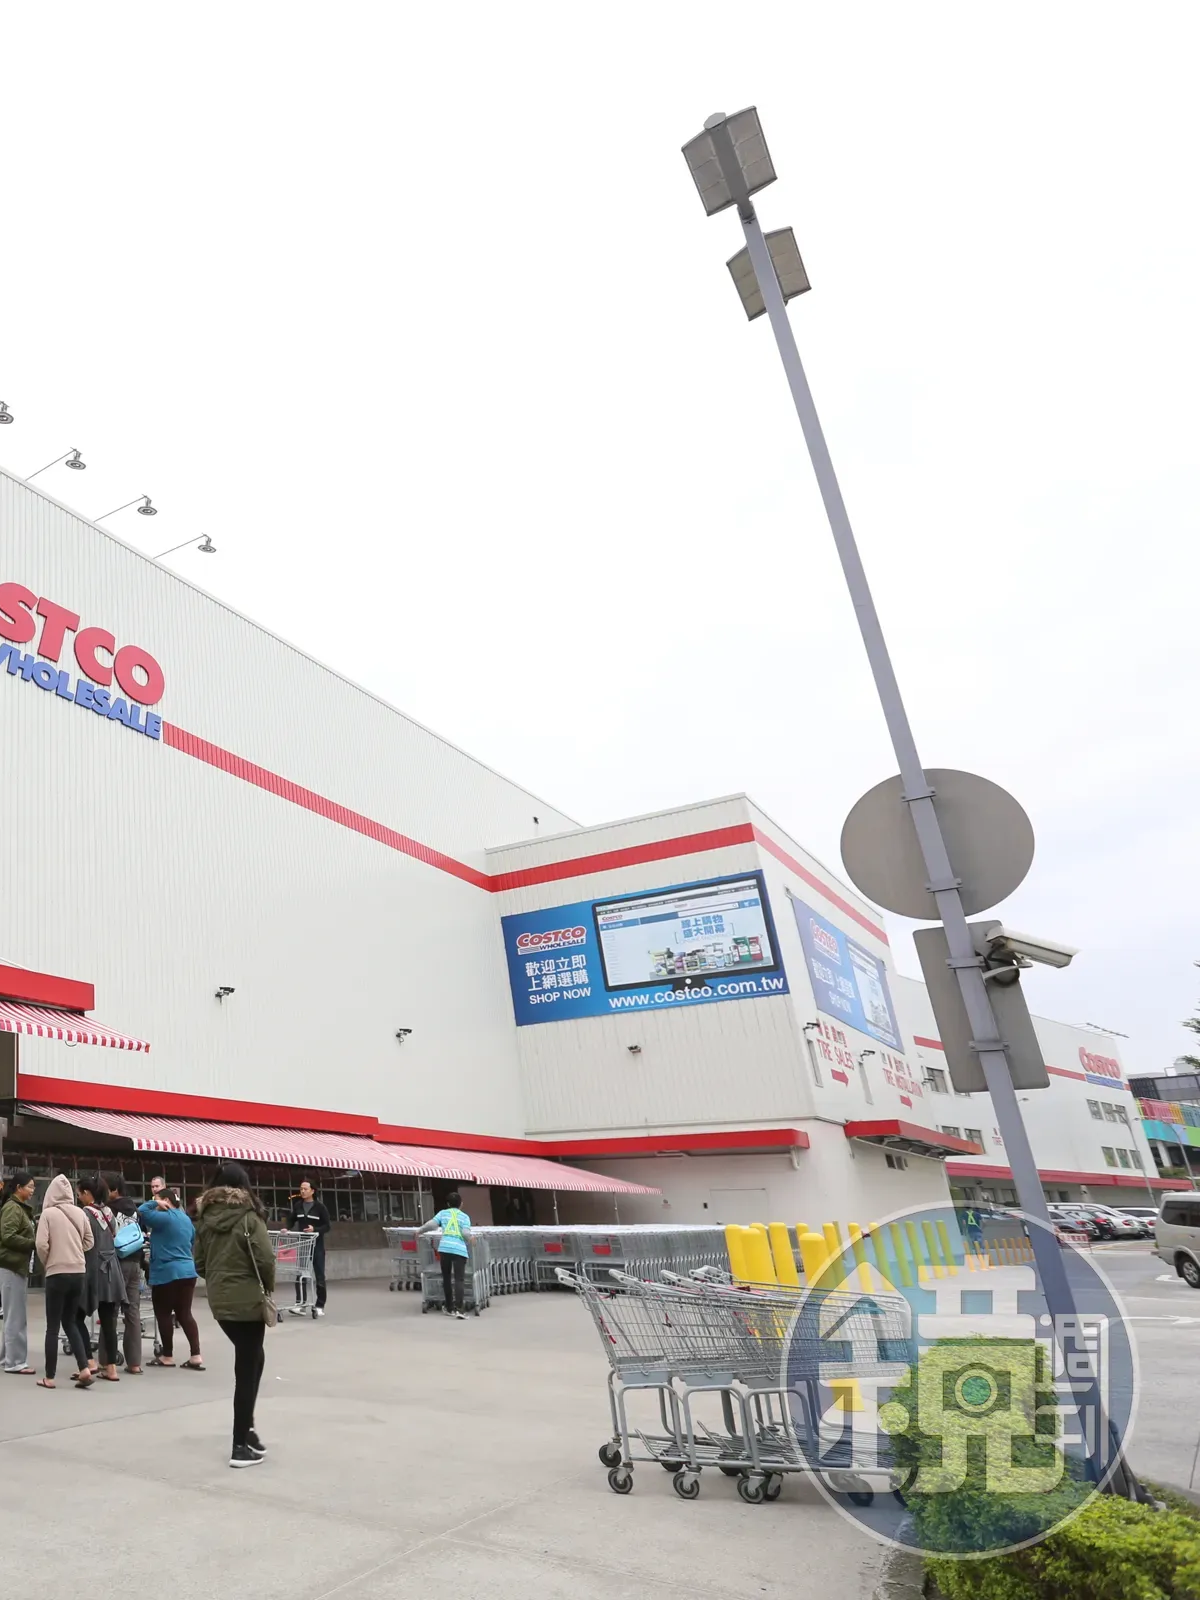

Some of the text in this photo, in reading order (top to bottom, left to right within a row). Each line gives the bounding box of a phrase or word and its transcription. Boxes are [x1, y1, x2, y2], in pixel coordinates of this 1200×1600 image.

[680, 914, 724, 929] 線上購物
[683, 923, 726, 939] 盛大開幕
[517, 926, 586, 948] COSTCO
[540, 937, 585, 950] WHOLESALE
[525, 954, 587, 977] 歡迎立即
[527, 969, 589, 992] 上網選購
[529, 987, 591, 1005] SHOP NOW
[609, 976, 784, 1009] www.costco.com.tw
[1079, 1047, 1120, 1079] COSTCO
